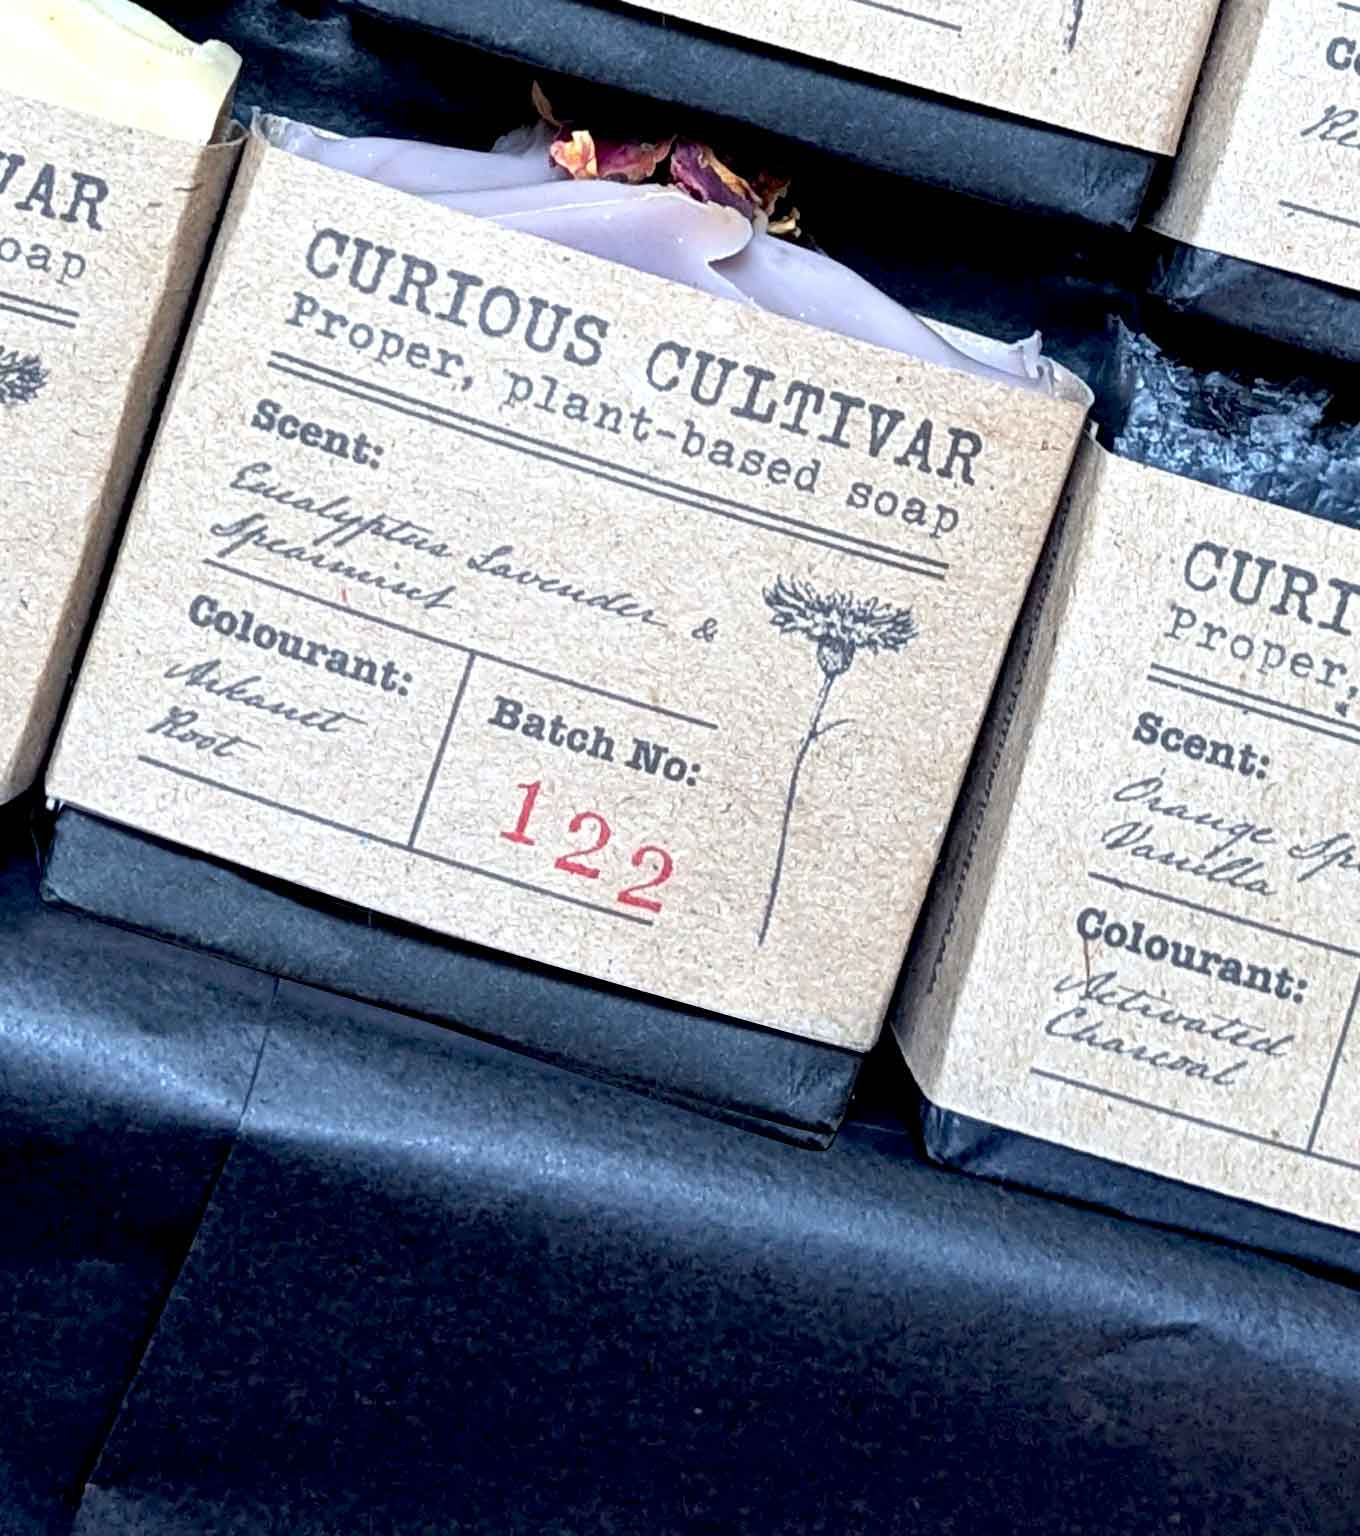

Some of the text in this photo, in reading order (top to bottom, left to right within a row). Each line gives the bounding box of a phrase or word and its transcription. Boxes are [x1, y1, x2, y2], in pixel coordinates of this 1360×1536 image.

[304, 226, 983, 487] CURIOUS CULTIVAR
[249, 397, 384, 470] Scent:
[283, 290, 959, 540] Proper, plant-based soap
[228, 461, 718, 643] Eucalyptus Lavender &
[187, 593, 413, 697] Colourant:
[1162, 600, 1359, 700] Proper,
[145, 704, 262, 758] Root
[486, 694, 701, 787] Batch No:
[1131, 710, 1271, 780] Scent:
[1099, 820, 1274, 897] Vanilla
[1101, 778, 1276, 860] Orange
[1075, 906, 1308, 1005] Colourant:
[1043, 1006, 1248, 1086] Charcoal
[1052, 959, 1295, 1057] Activated
